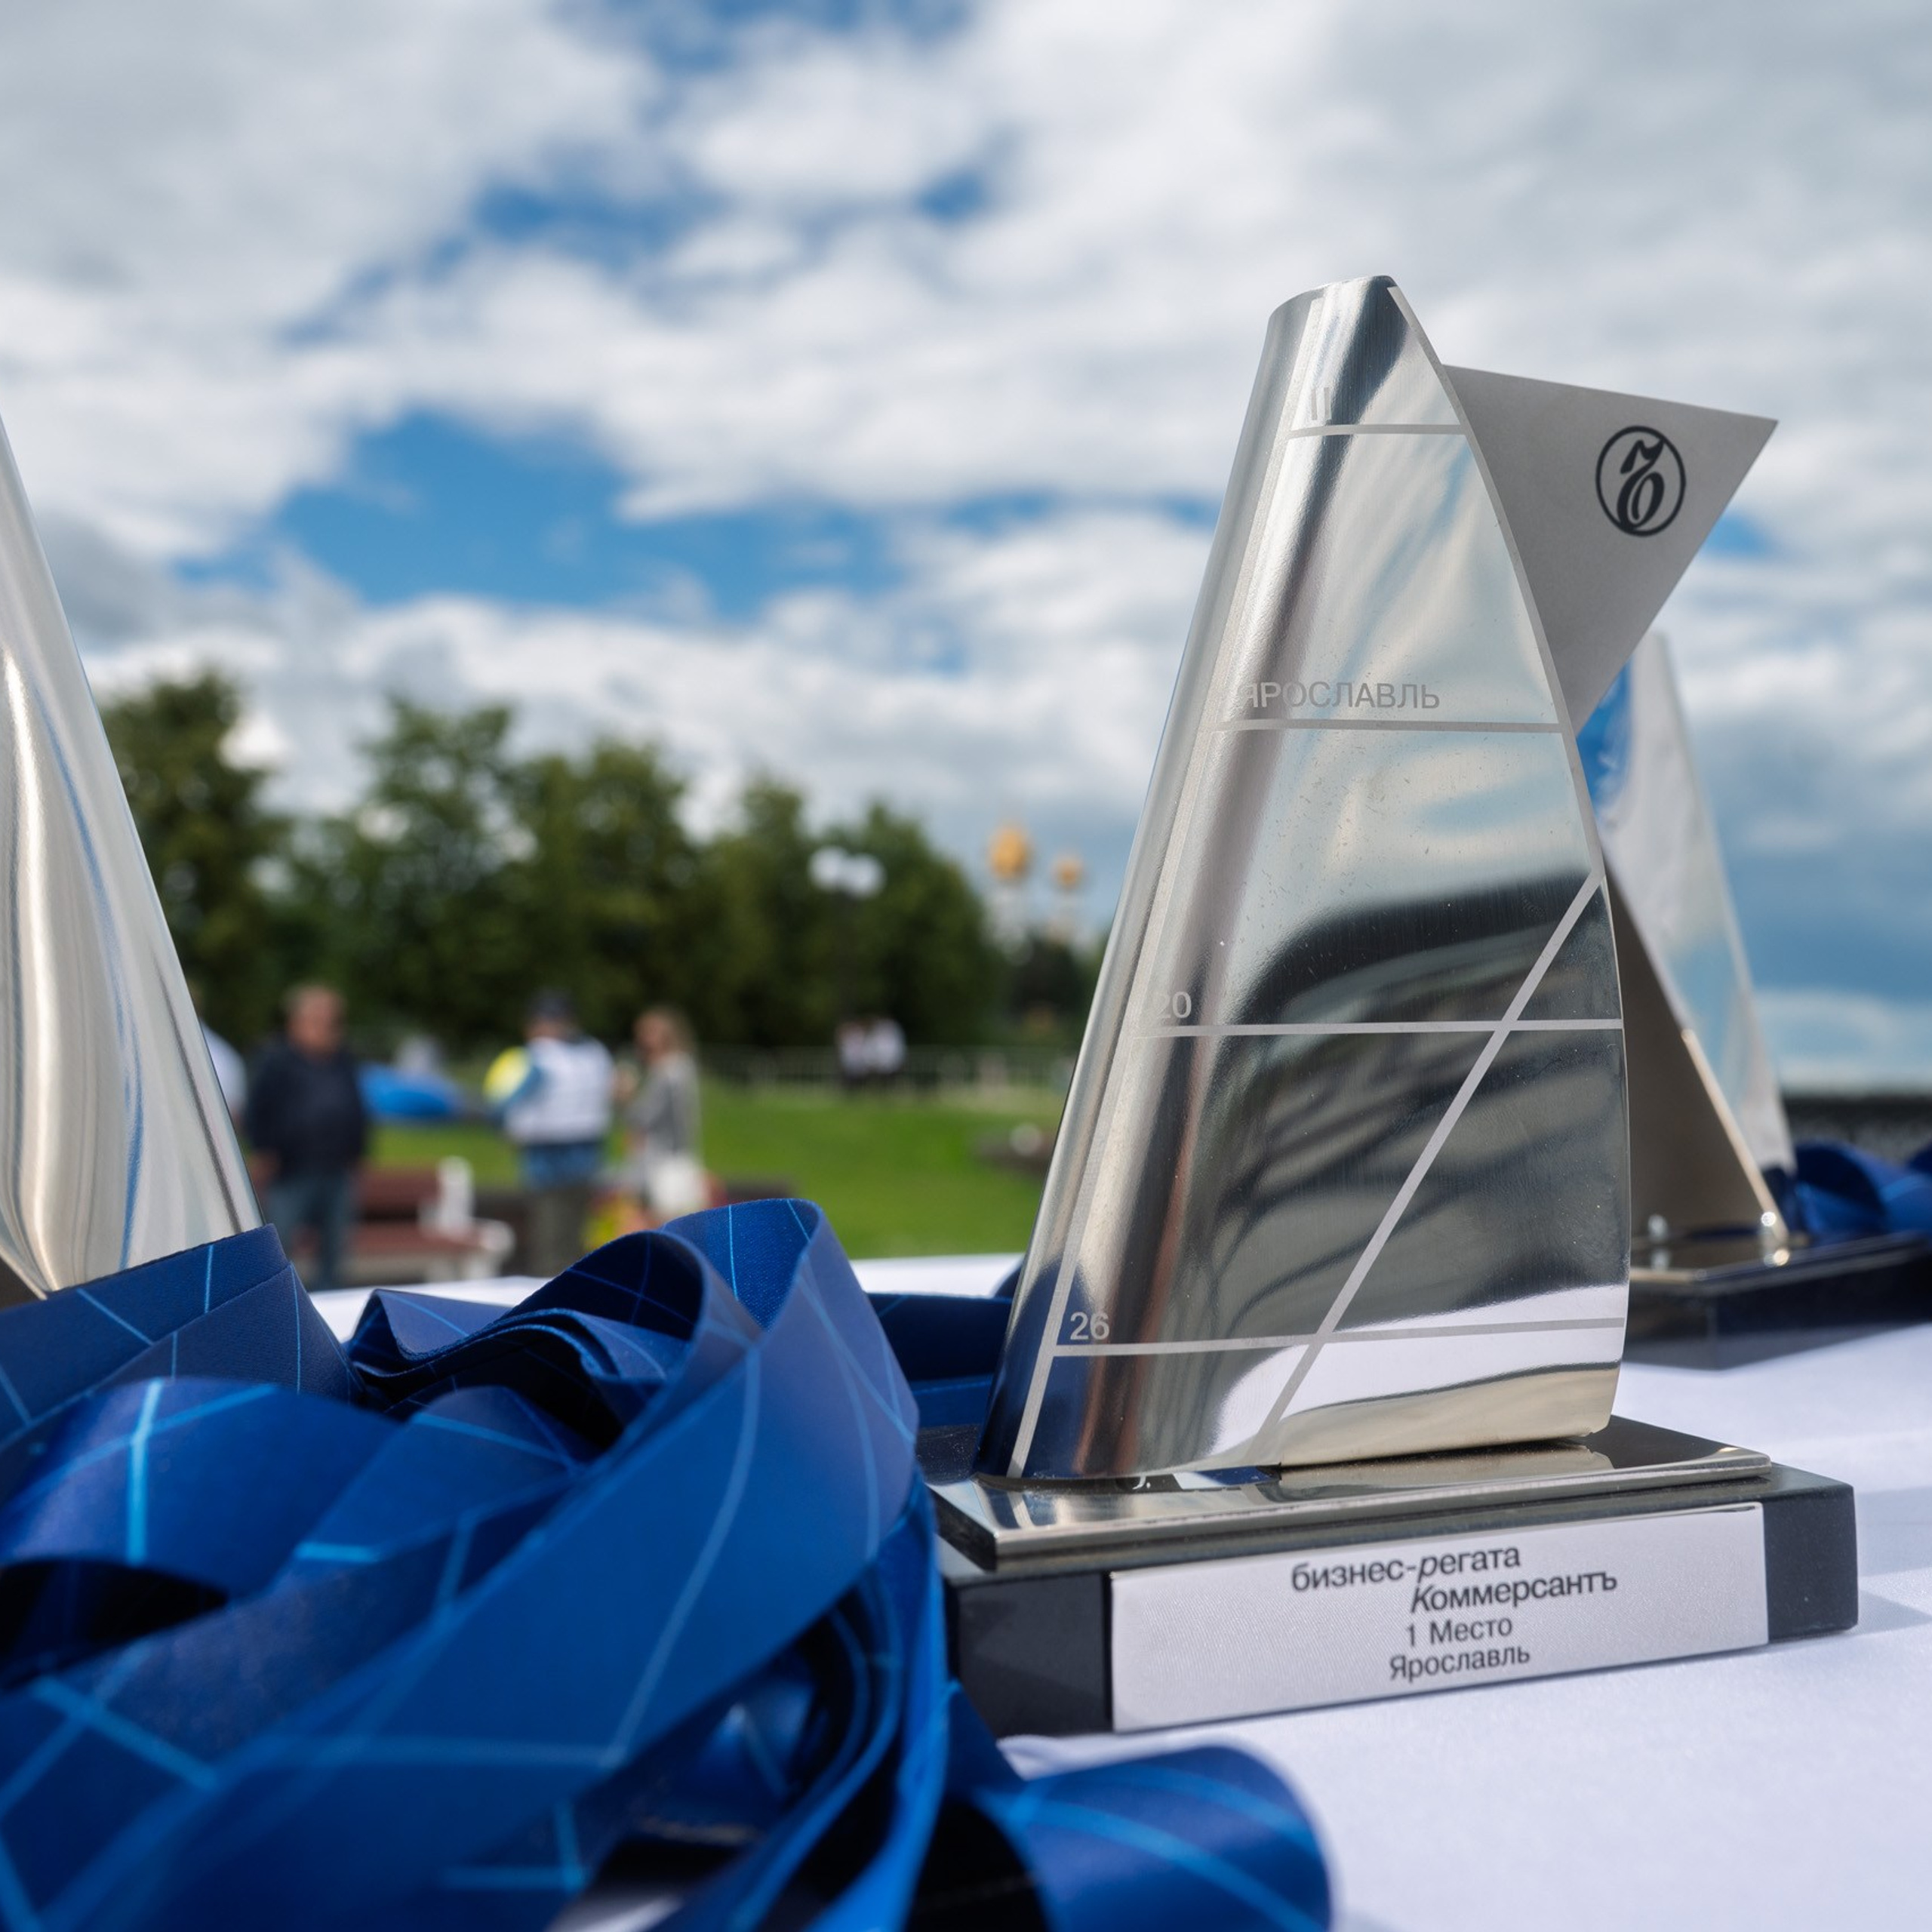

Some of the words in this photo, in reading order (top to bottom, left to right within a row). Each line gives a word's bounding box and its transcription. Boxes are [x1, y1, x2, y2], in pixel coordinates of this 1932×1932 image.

[1238, 681, 1440, 709] ЯРОСЛАВЛЬ
[1069, 1311, 1110, 1340] 26
[1291, 1546, 1521, 1591] бизнес-регата
[1411, 1571, 1617, 1614] Коммерсантъ
[1406, 1624, 1416, 1647] 1
[1429, 1617, 1513, 1645] Место
[1389, 1645, 1531, 1682] Ярославль
